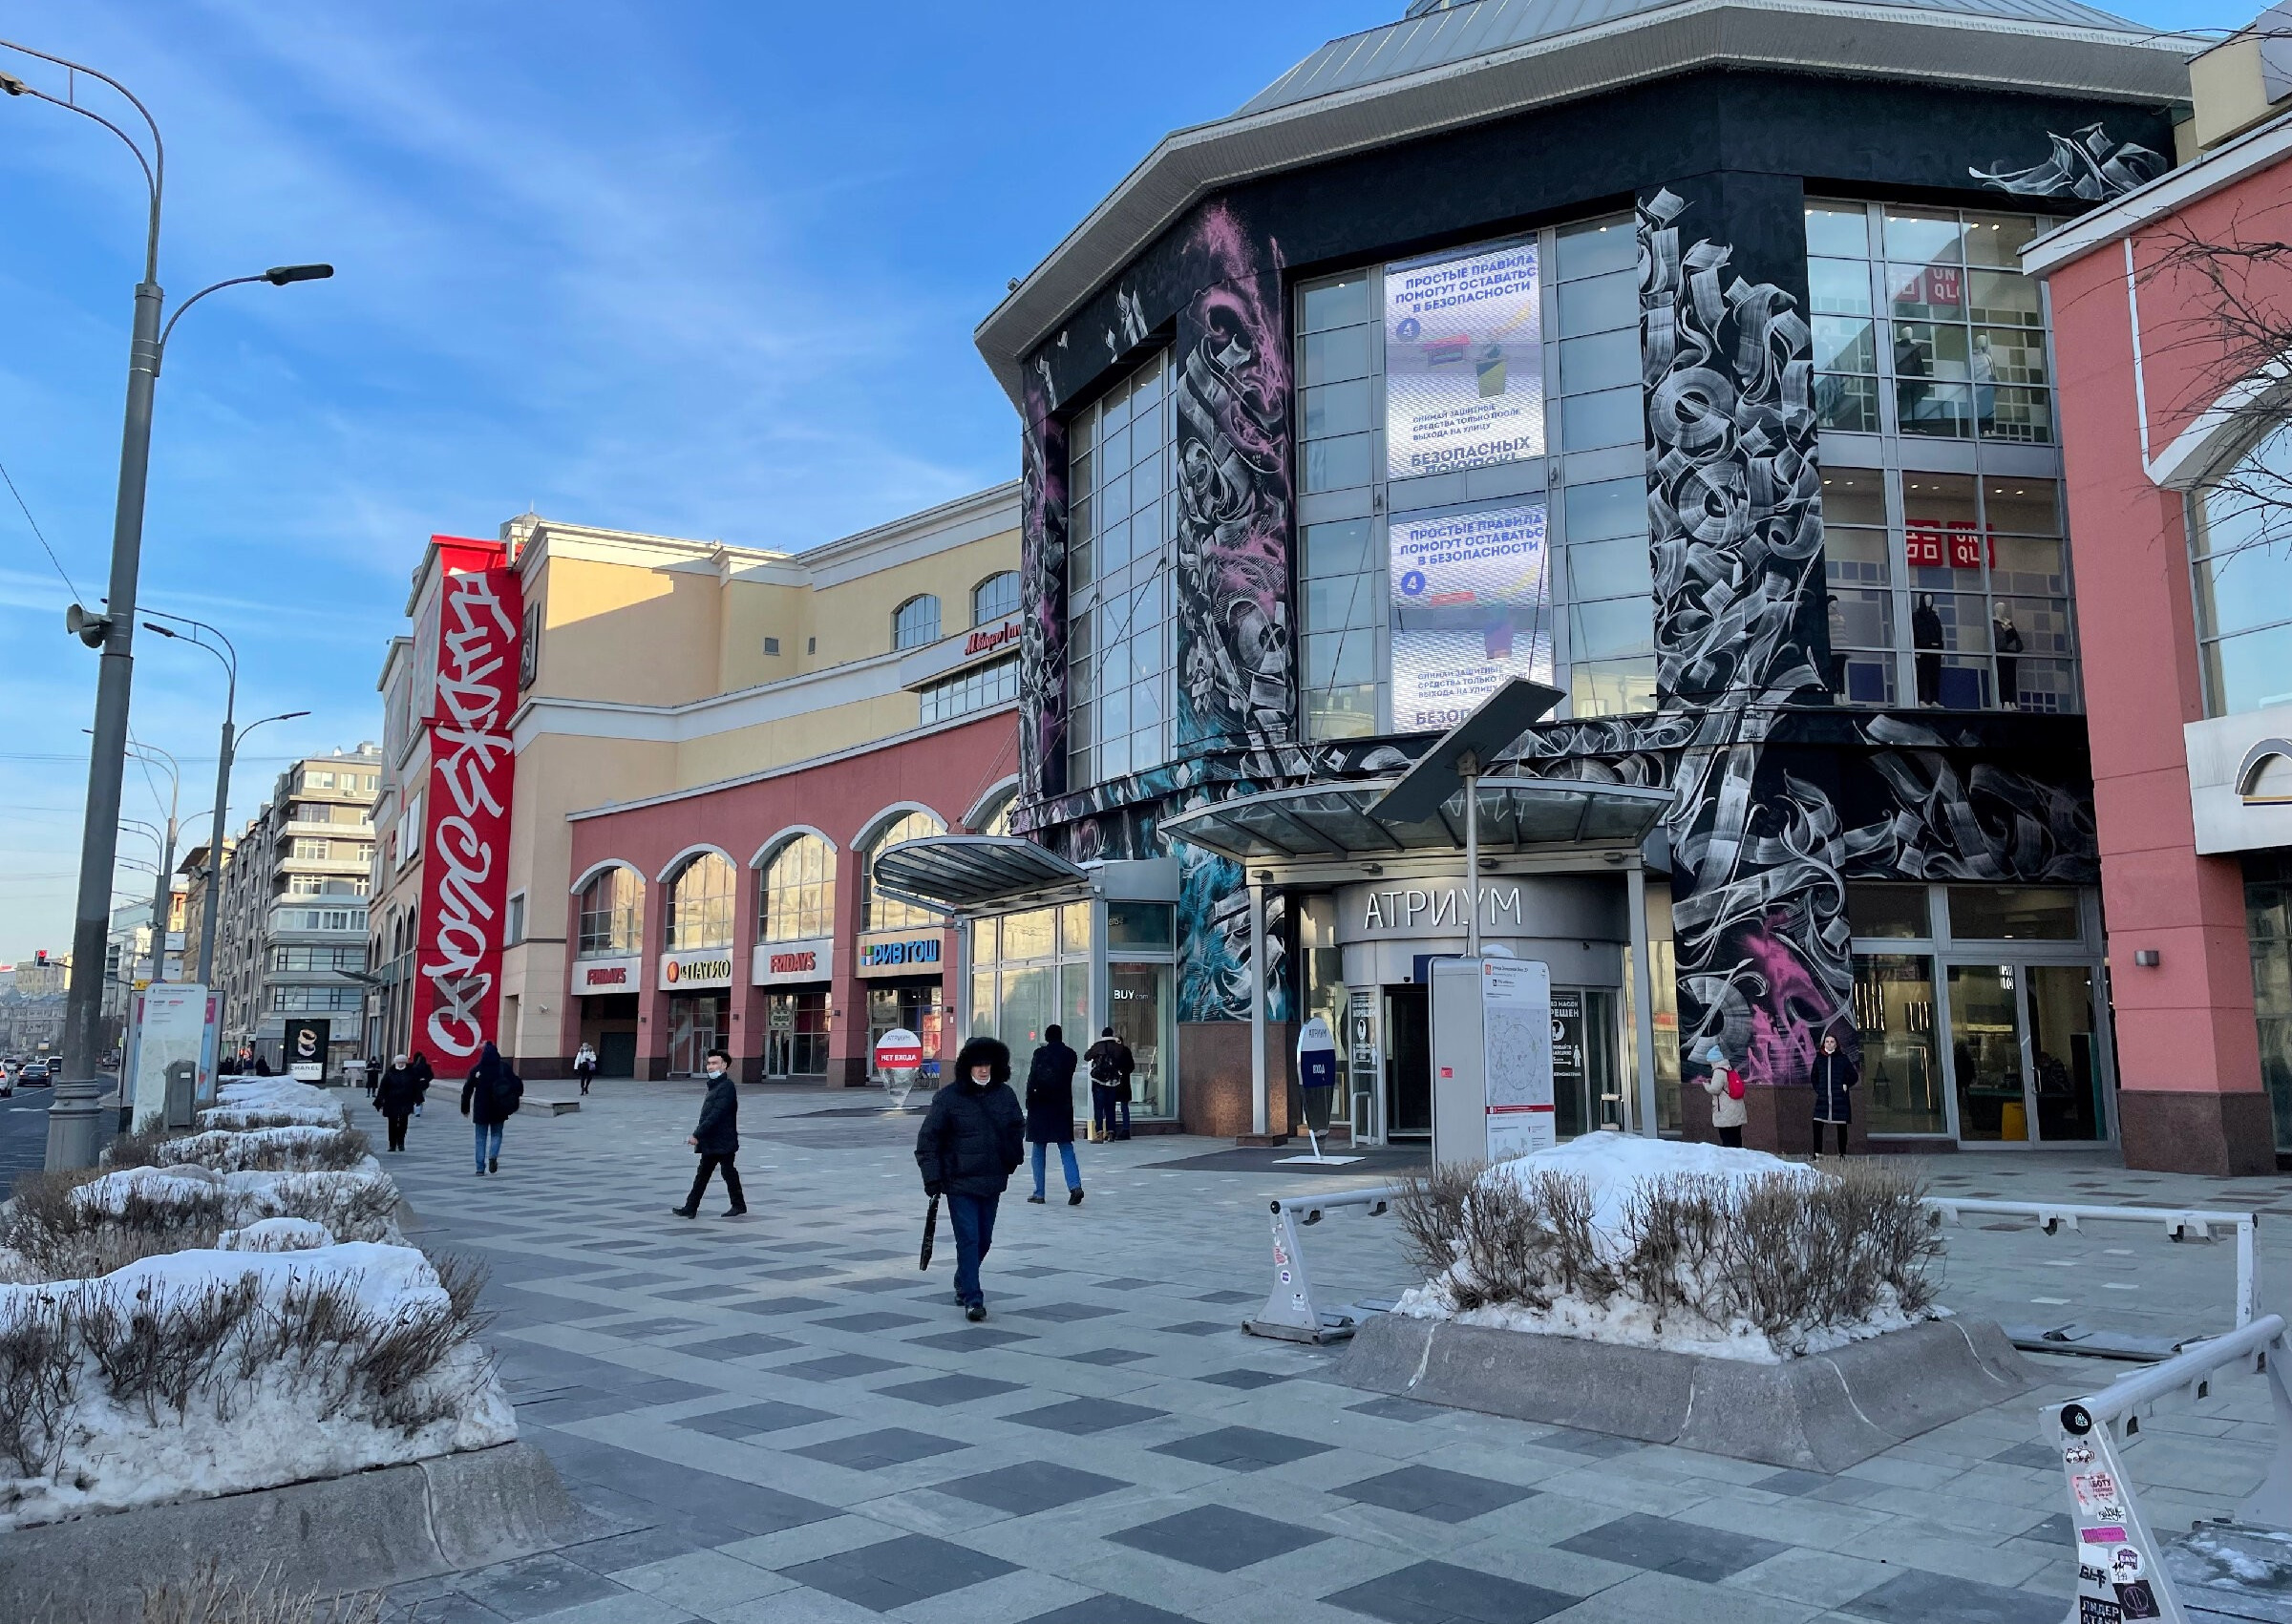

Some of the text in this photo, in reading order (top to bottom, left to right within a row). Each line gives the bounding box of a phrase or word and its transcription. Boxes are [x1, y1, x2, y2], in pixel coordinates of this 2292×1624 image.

[1406, 254, 1535, 289] ПРОСТЫЕ ПРАВИЛА
[1933, 267, 1955, 282] UN
[1395, 266, 1539, 305] ПОМОГУТ ОСТАВАТЬС
[1935, 284, 1960, 300] QL
[1412, 281, 1531, 313] В БЕЗОПАСНОСТИ
[1413, 421, 1455, 432] СРЕДСТВА
[1413, 430, 1449, 441] ВЫХОДА
[1411, 436, 1531, 467] БЕЗОПАСНЫХ
[1410, 514, 1542, 541] ПРОСТЫЕ ПРАВИЛА
[1956, 527, 1979, 543] UN
[1400, 527, 1544, 555] ПОМОГУТ ОСТАВАТЬС
[1418, 541, 1539, 565] В БЕЗОПАСНОСТИ
[1957, 545, 1989, 563] QL
[1418, 680, 1461, 689] СРЕДСТВА
[1463, 676, 1496, 685] ТОЛЬКО
[1419, 690, 1454, 699] ВЫХОДА
[873, 939, 940, 965] РИВ ГОШ
[770, 951, 817, 974] FRIDAYS
[1114, 989, 1135, 1000] BUY
[2081, 1600, 2120, 1618] ЛИДЕР
